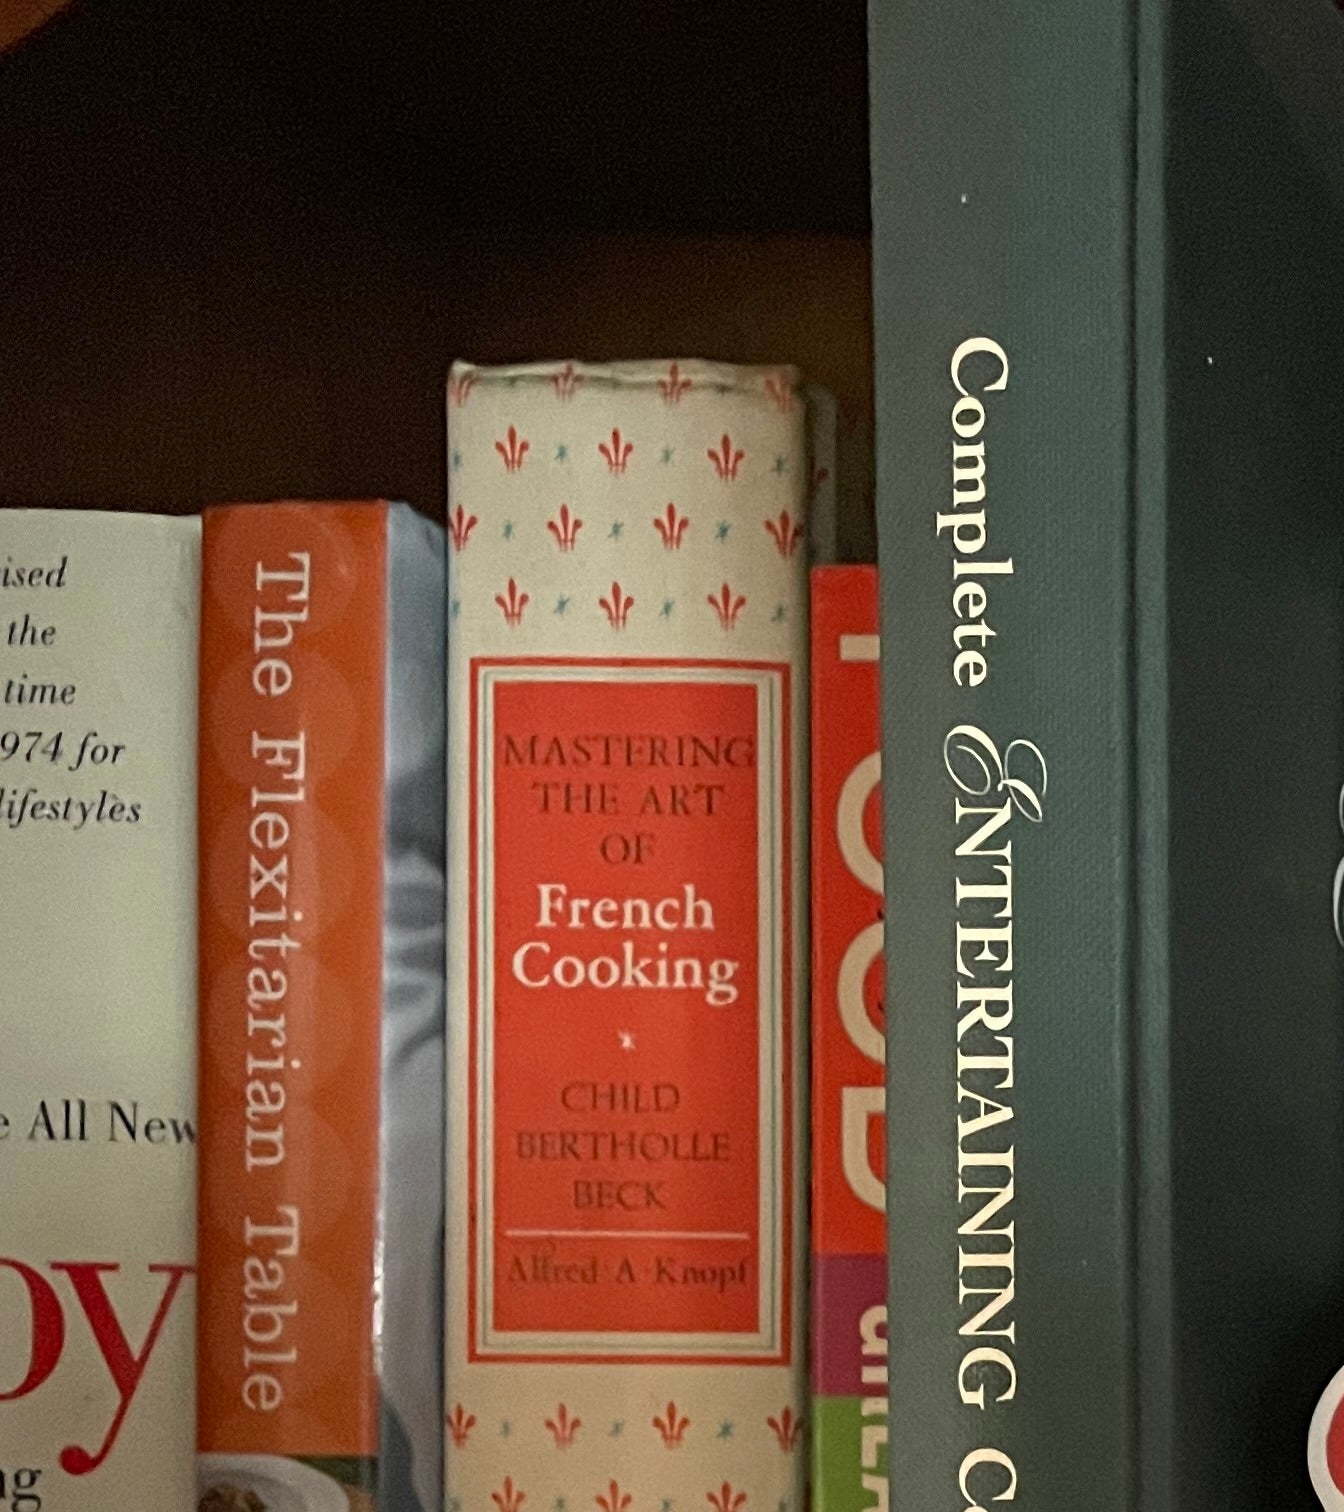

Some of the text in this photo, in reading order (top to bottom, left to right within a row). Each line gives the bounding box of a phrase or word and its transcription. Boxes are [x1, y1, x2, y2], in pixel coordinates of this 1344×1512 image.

[935, 336, 1015, 688] Complete
[0, 555, 69, 589] ised
[7, 612, 57, 647] the
[3, 672, 77, 705] time
[67, 730, 127, 772] for
[503, 734, 755, 769] MASTERING
[531, 781, 725, 817] THE ART
[599, 832, 656, 866] OF
[534, 882, 716, 931] French
[241, 551, 312, 1412] The Flexitarian Table
[511, 939, 740, 1007] Cooking
[942, 724, 1048, 1411] ENTERTAINING
[560, 1082, 681, 1114] CHILD
[27, 1098, 89, 1142] All
[516, 1131, 731, 1162] BERTHOLLE
[573, 1178, 667, 1211] BECK
